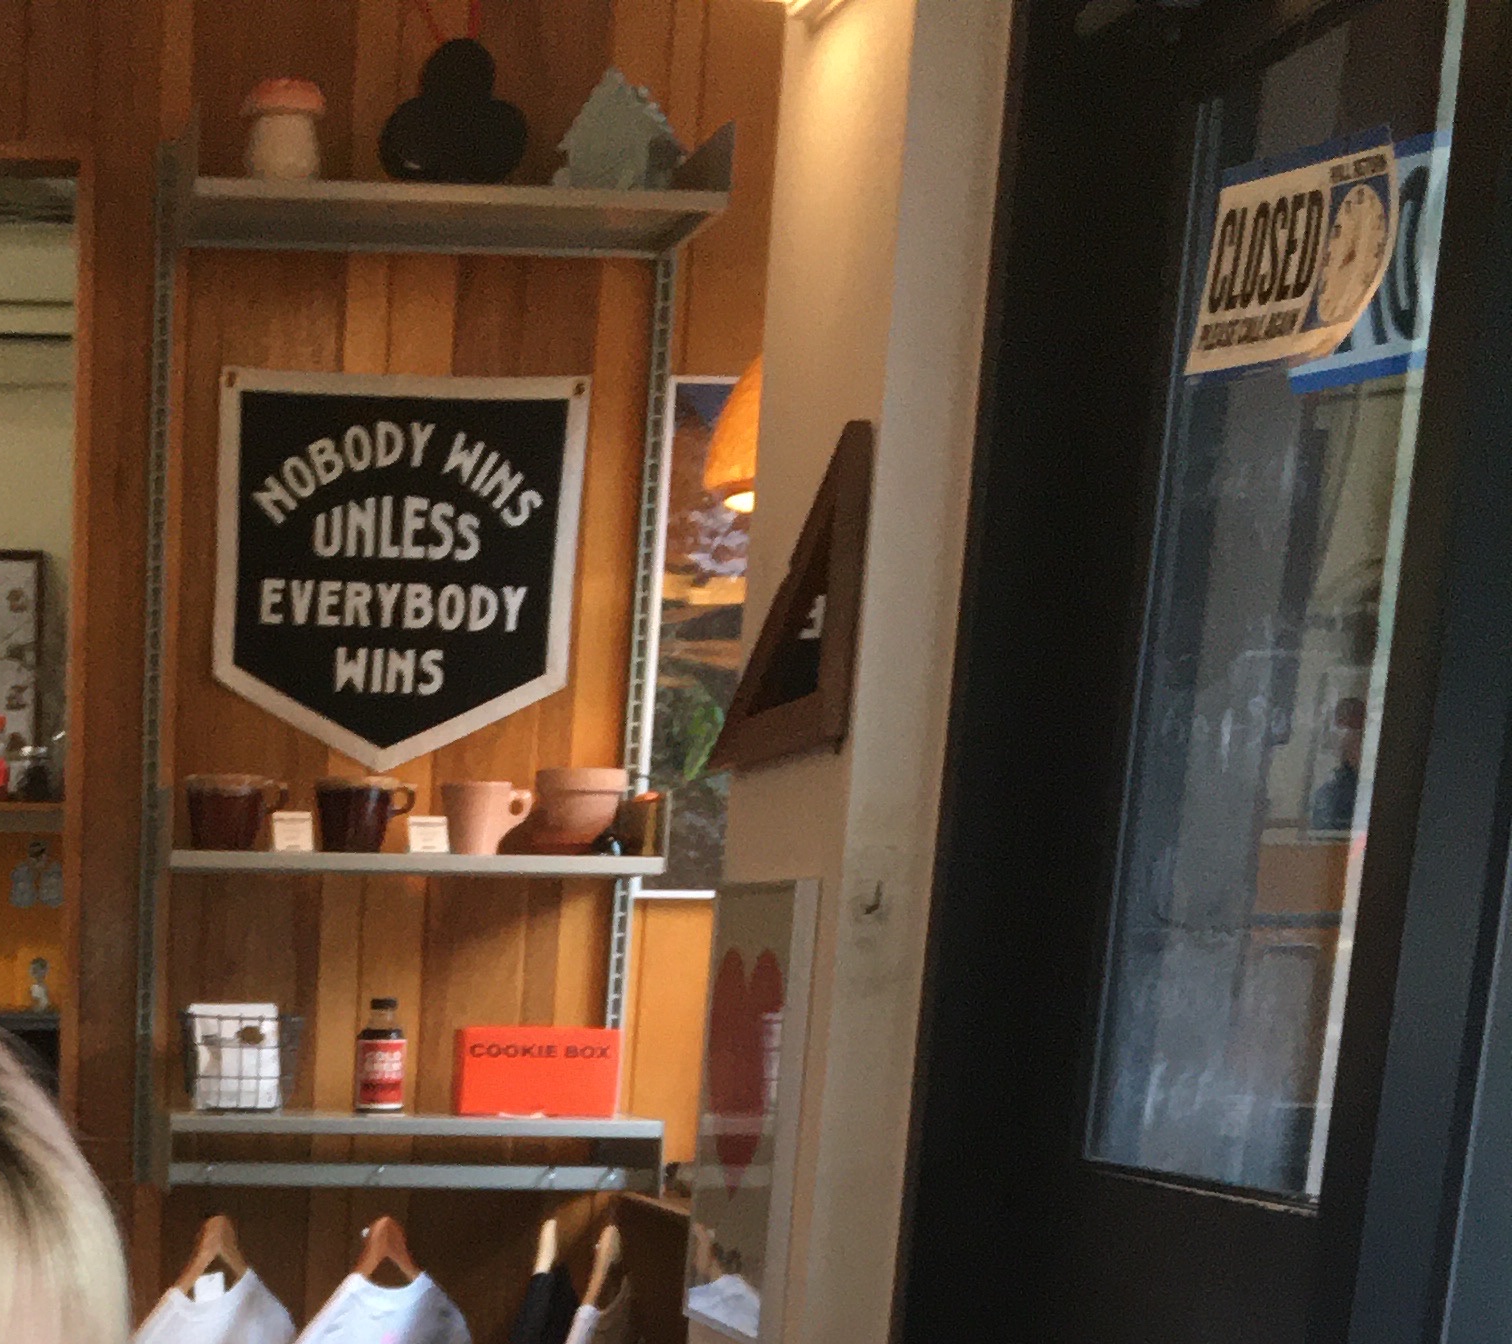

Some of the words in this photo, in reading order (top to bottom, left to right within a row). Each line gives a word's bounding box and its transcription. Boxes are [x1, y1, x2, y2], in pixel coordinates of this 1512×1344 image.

[1207, 189, 1324, 314] CLOSED
[251, 420, 436, 525] NOBODY
[441, 431, 544, 528] WINS
[312, 495, 481, 562] UNLESS
[258, 577, 529, 633] EVERYBODY
[333, 646, 445, 696] WINS
[469, 1043, 558, 1059] COOKIE
[564, 1044, 611, 1059] BOX
